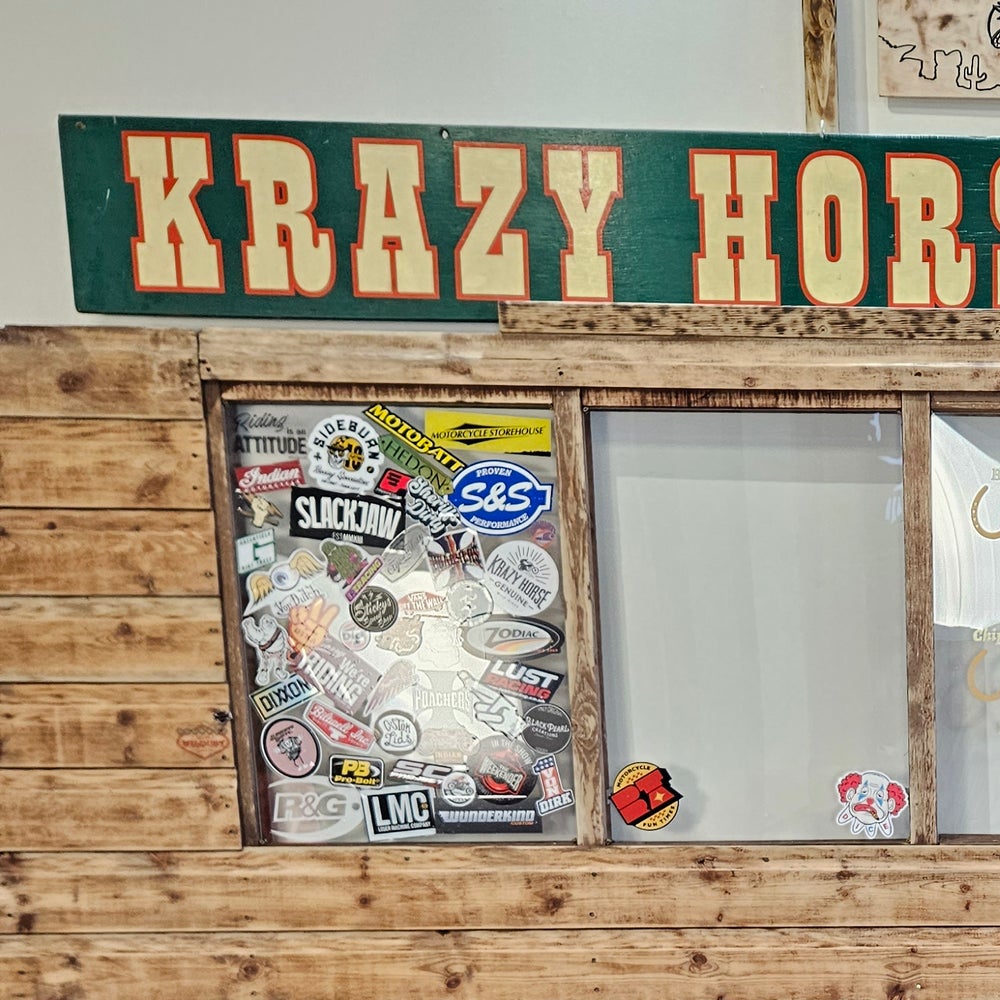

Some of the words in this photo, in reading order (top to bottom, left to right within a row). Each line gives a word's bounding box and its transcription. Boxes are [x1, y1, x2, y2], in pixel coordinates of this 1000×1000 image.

[121, 130, 624, 302] KRAZY
[238, 411, 288, 433] Riding
[431, 428, 488, 439] MOTORCYCLE
[489, 426, 545, 438] STOREHOUSE
[235, 434, 307, 454] ATTITUDE
[313, 419, 379, 460] SIDEBURN
[368, 404, 465, 472] MOTOBATT
[239, 467, 300, 488] Indian
[475, 467, 513, 478] PROVEN
[458, 481, 533, 513] S&S
[295, 495, 402, 541] SLACKJAW
[470, 512, 529, 530] PERFORMANCE
[487, 554, 522, 585] KRAZY
[518, 577, 552, 610] HORSE
[494, 581, 529, 607] GENUINE
[484, 627, 540, 649] ZODIAC
[491, 659, 559, 688] LUST
[260, 679, 312, 713] DIXXON
[487, 673, 552, 700] RACING
[341, 759, 371, 777] PB
[617, 765, 651, 788] MOTORCYCLE
[333, 775, 376, 786] Pro-Bolt
[276, 793, 347, 818] R&G
[371, 791, 430, 827] LMC
[539, 792, 573, 814] DIRK
[642, 821, 658, 829] FUN
[660, 805, 675, 824] TIMES
